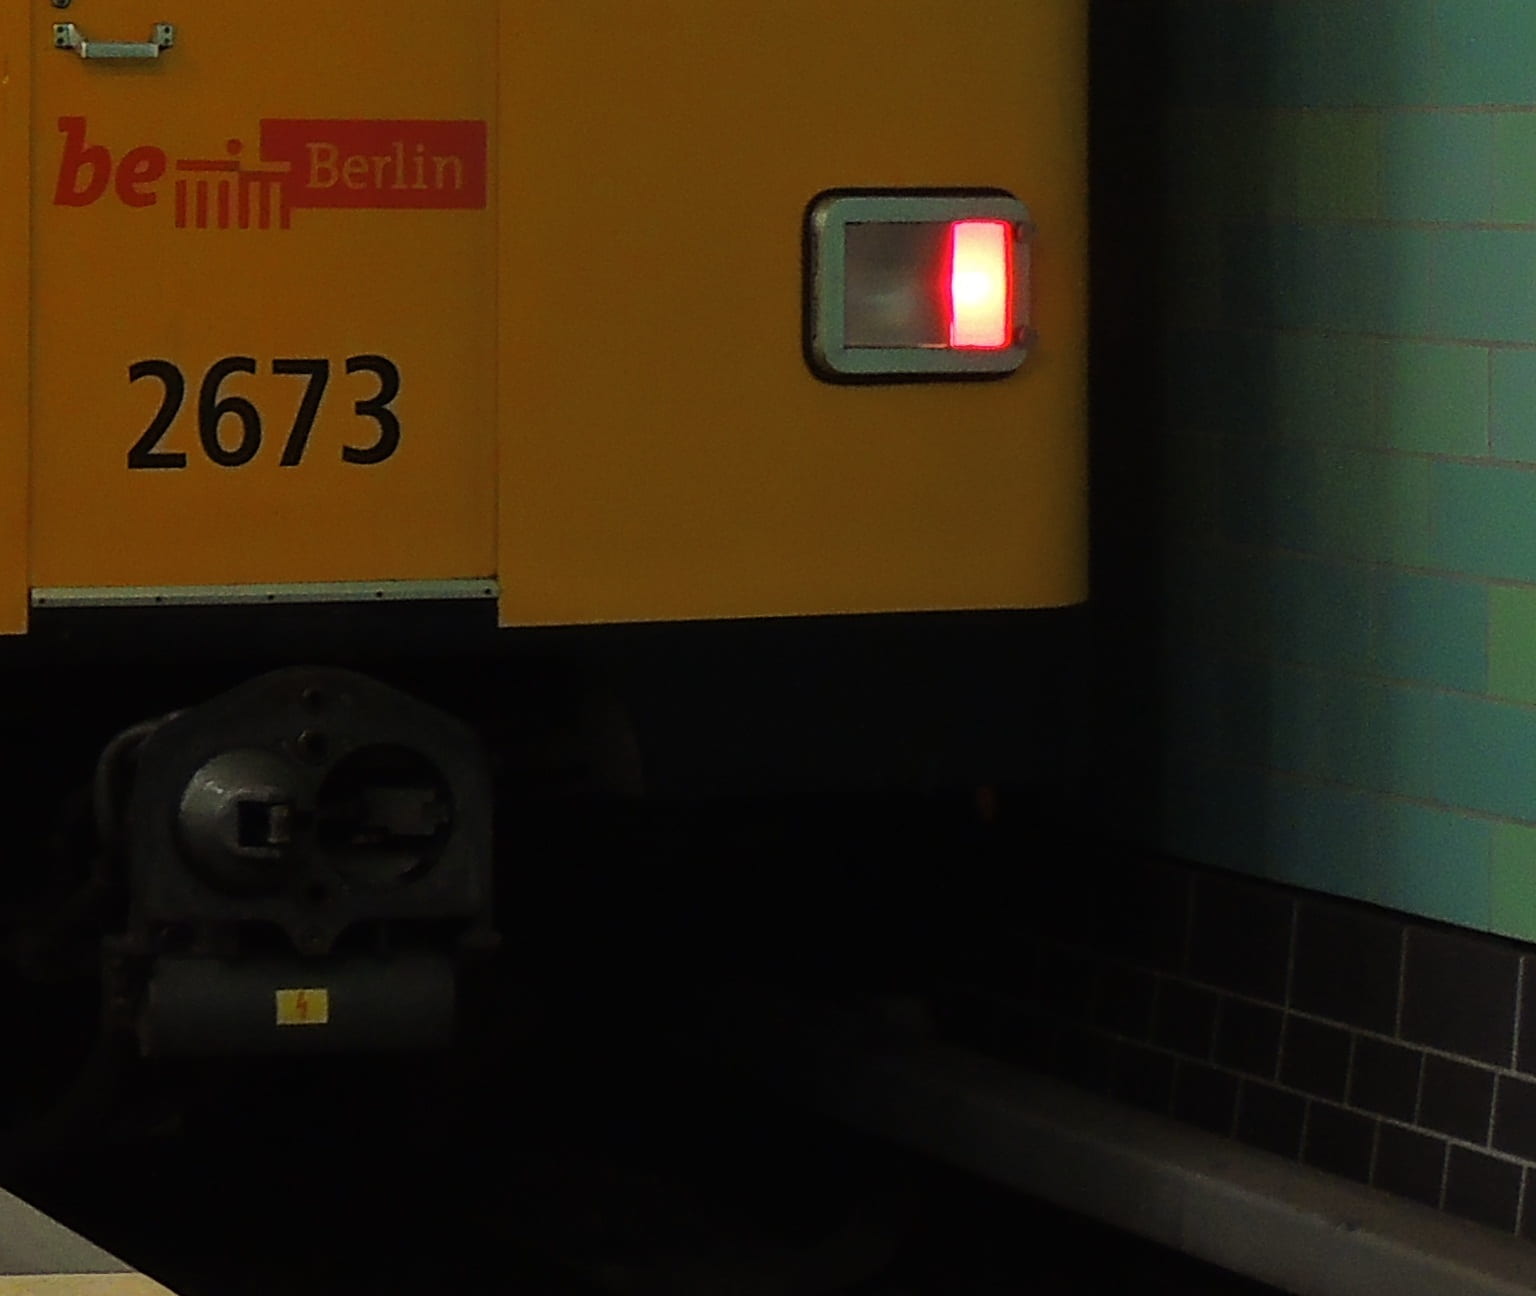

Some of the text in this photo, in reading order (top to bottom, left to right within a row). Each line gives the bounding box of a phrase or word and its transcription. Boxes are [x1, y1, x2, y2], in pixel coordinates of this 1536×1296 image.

[53, 115, 463, 208] be Berlin
[127, 354, 401, 470] 2673
